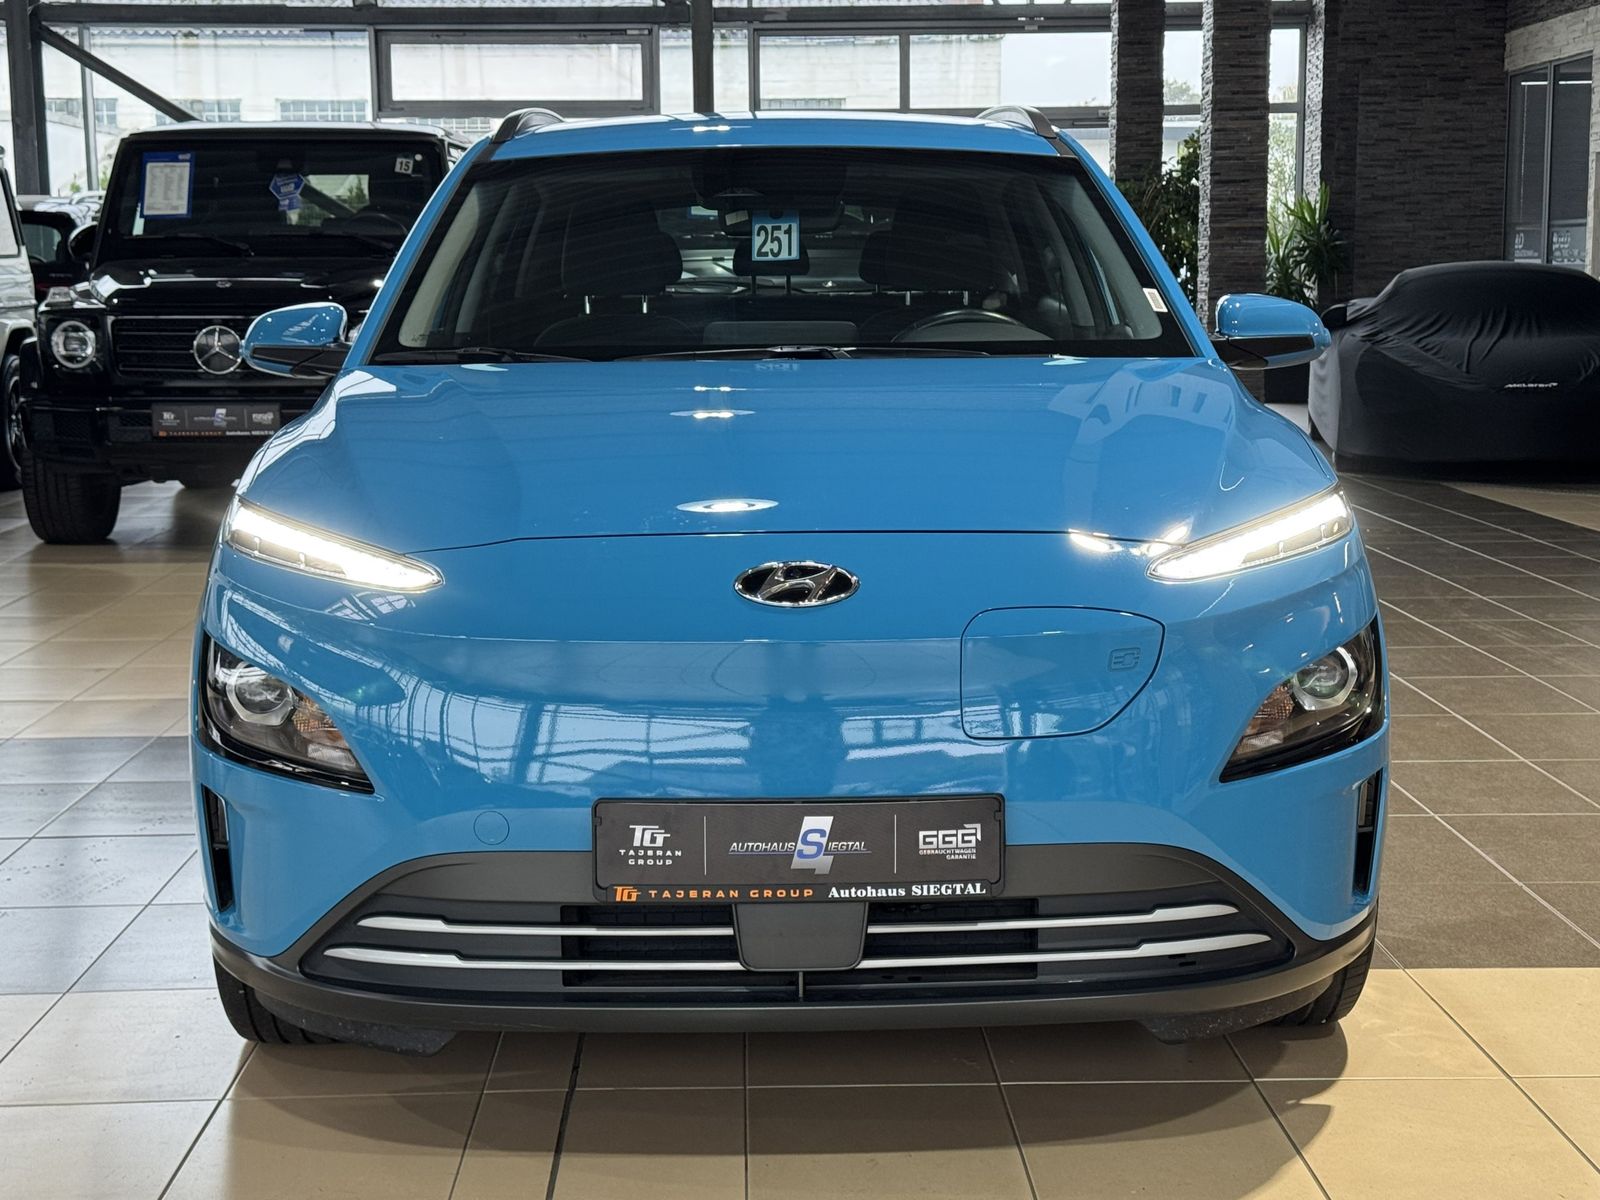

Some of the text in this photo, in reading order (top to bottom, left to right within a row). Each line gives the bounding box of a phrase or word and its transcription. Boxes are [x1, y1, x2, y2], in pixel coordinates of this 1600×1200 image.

[399, 161, 411, 172] 15
[756, 224, 793, 258] 251
[629, 825, 671, 847] TG
[919, 829, 977, 849] GGG
[619, 849, 682, 857] TAJERAN
[729, 842, 796, 852] AUTOHAUS
[649, 890, 739, 898] TAJERAN
[749, 889, 814, 898] GROUP
[828, 886, 906, 898] Autohaus
[911, 883, 986, 896] SIEGTAL
